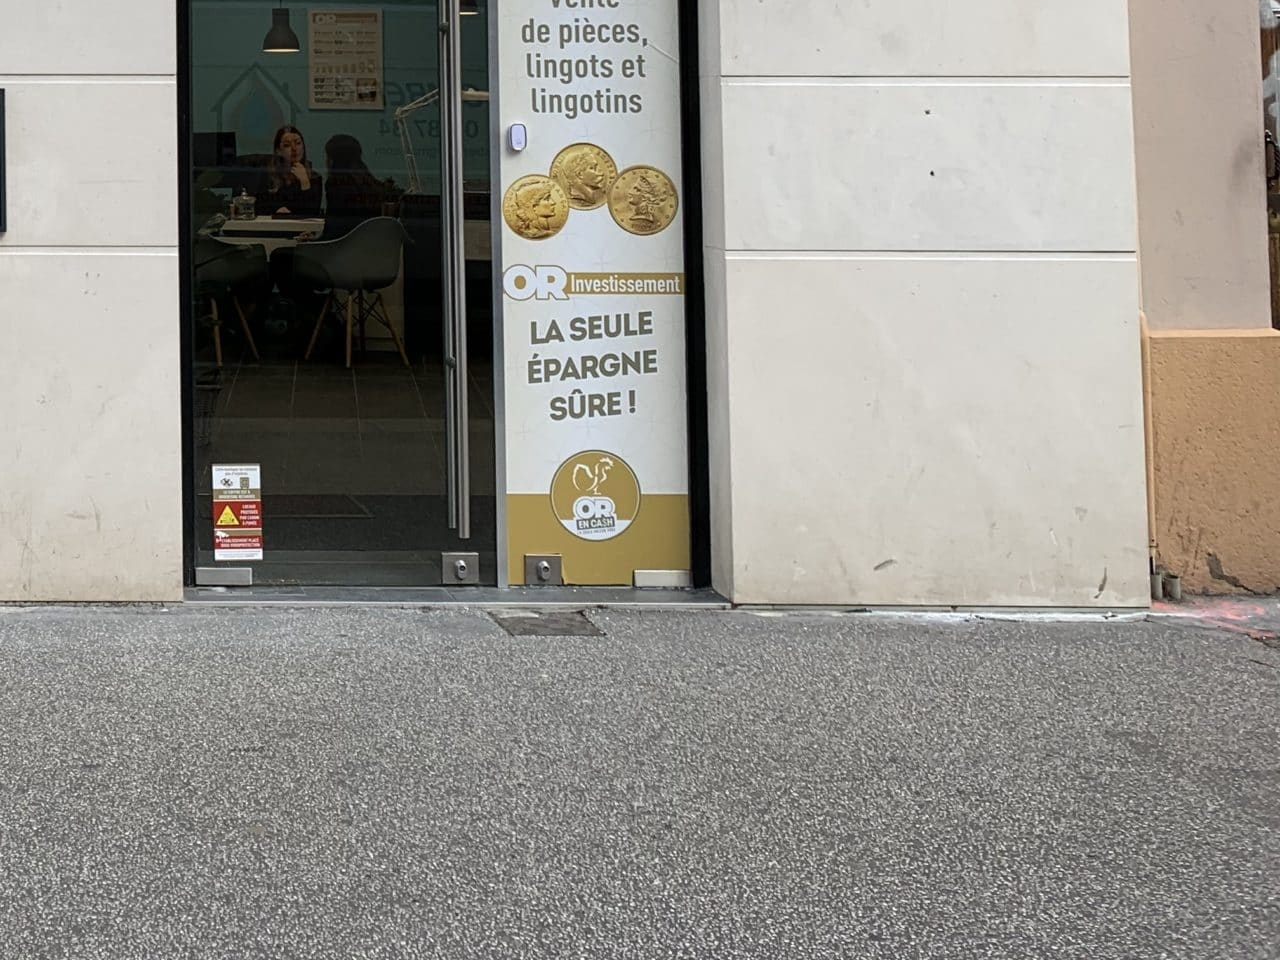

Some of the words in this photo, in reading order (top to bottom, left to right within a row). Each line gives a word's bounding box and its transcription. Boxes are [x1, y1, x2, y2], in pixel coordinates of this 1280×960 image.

[521, 18, 550, 44] de
[559, 17, 648, 49] pièces,
[526, 53, 614, 84] lingots
[621, 54, 646, 79] et
[531, 88, 643, 119] lingotins
[503, 263, 569, 300] OR
[571, 275, 681, 294] Investissement
[530, 319, 565, 345] LA
[570, 311, 653, 341] SEULE
[527, 349, 658, 385] ÉPARGNE
[549, 388, 621, 421] SÛRE
[628, 390, 636, 414] !
[574, 497, 614, 519] OR
[578, 520, 589, 529] EN
